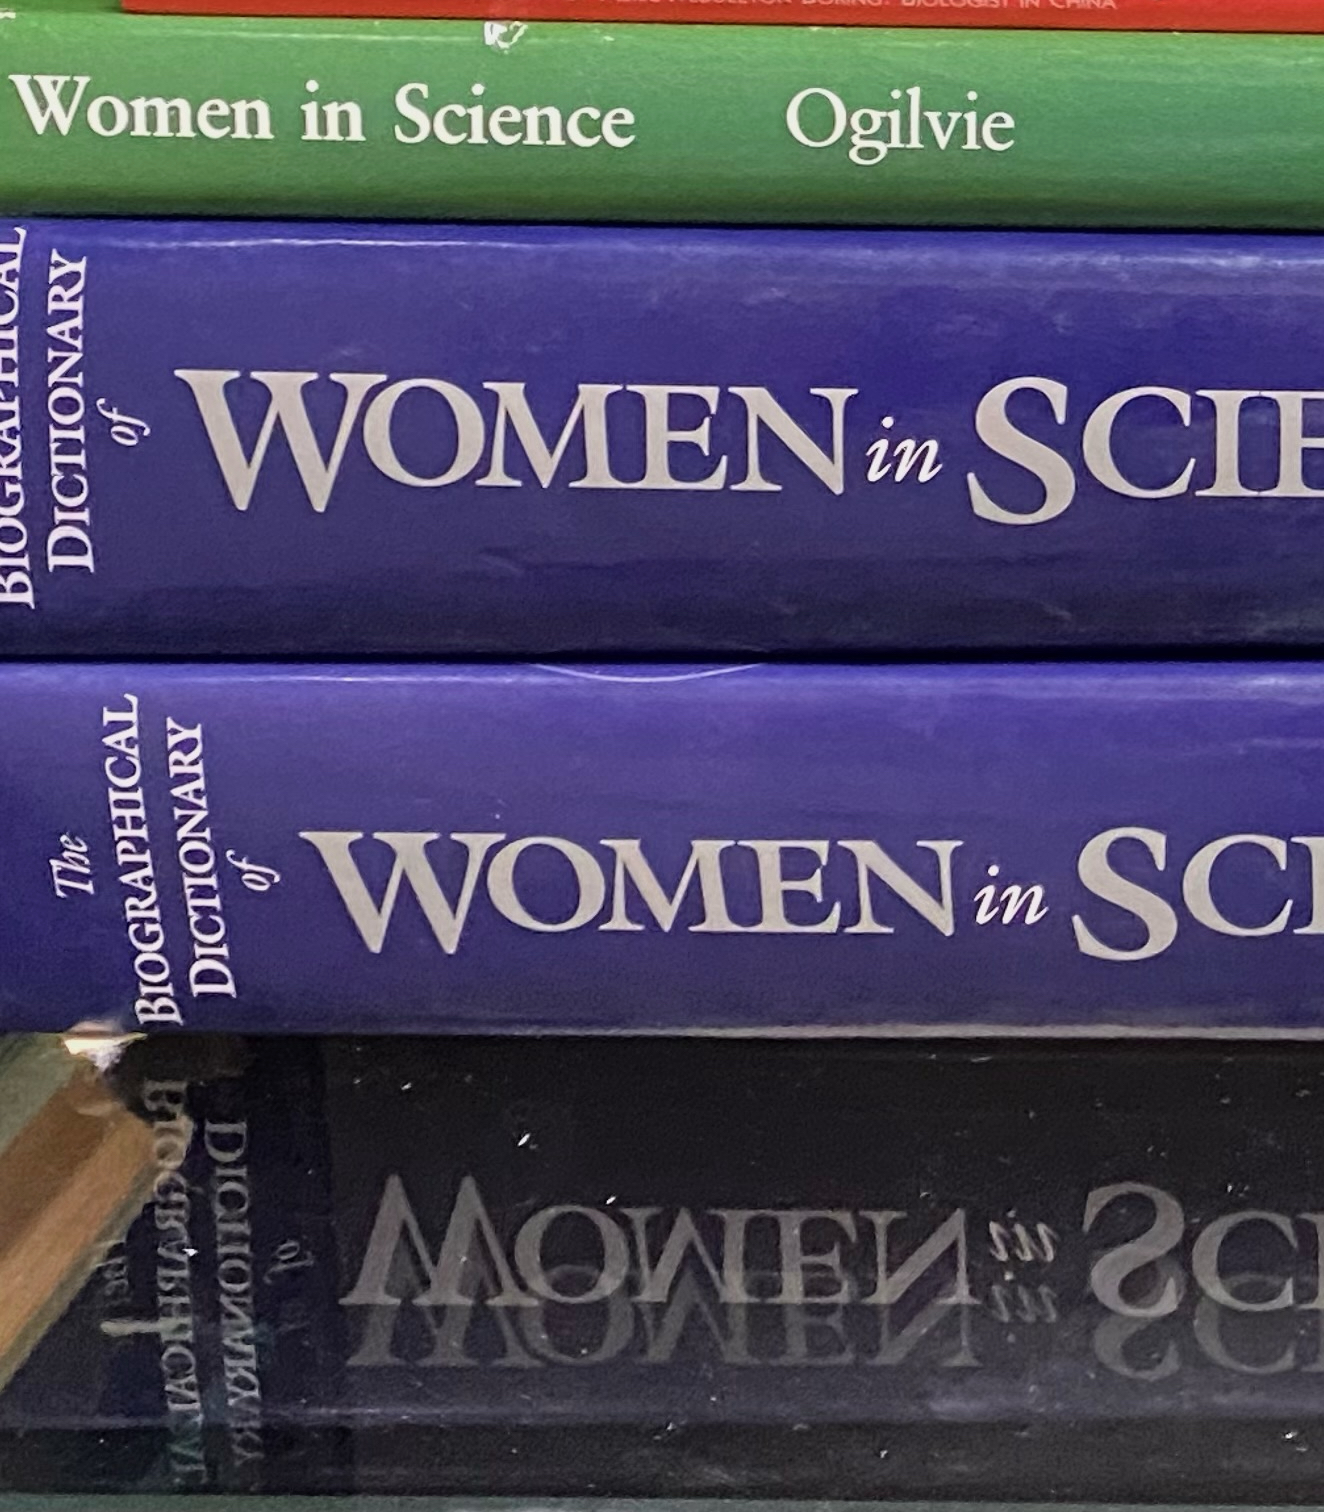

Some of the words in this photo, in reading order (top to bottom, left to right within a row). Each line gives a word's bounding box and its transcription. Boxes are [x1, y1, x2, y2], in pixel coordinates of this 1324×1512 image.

[8, 72, 275, 145] Women
[300, 79, 366, 145] in
[392, 80, 637, 152] Science
[785, 86, 1016, 167] Ogilvie
[47, 248, 95, 573] DICTIONARY
[96, 397, 151, 448] of
[174, 368, 860, 514] WOMEN
[864, 414, 943, 484] in
[49, 831, 95, 899] The
[101, 692, 184, 1027] BIOGRAPHICAL
[166, 716, 237, 999] DICTIONARY
[226, 848, 282, 892] of
[298, 830, 964, 955] WOMEN
[972, 866, 1049, 932] in
